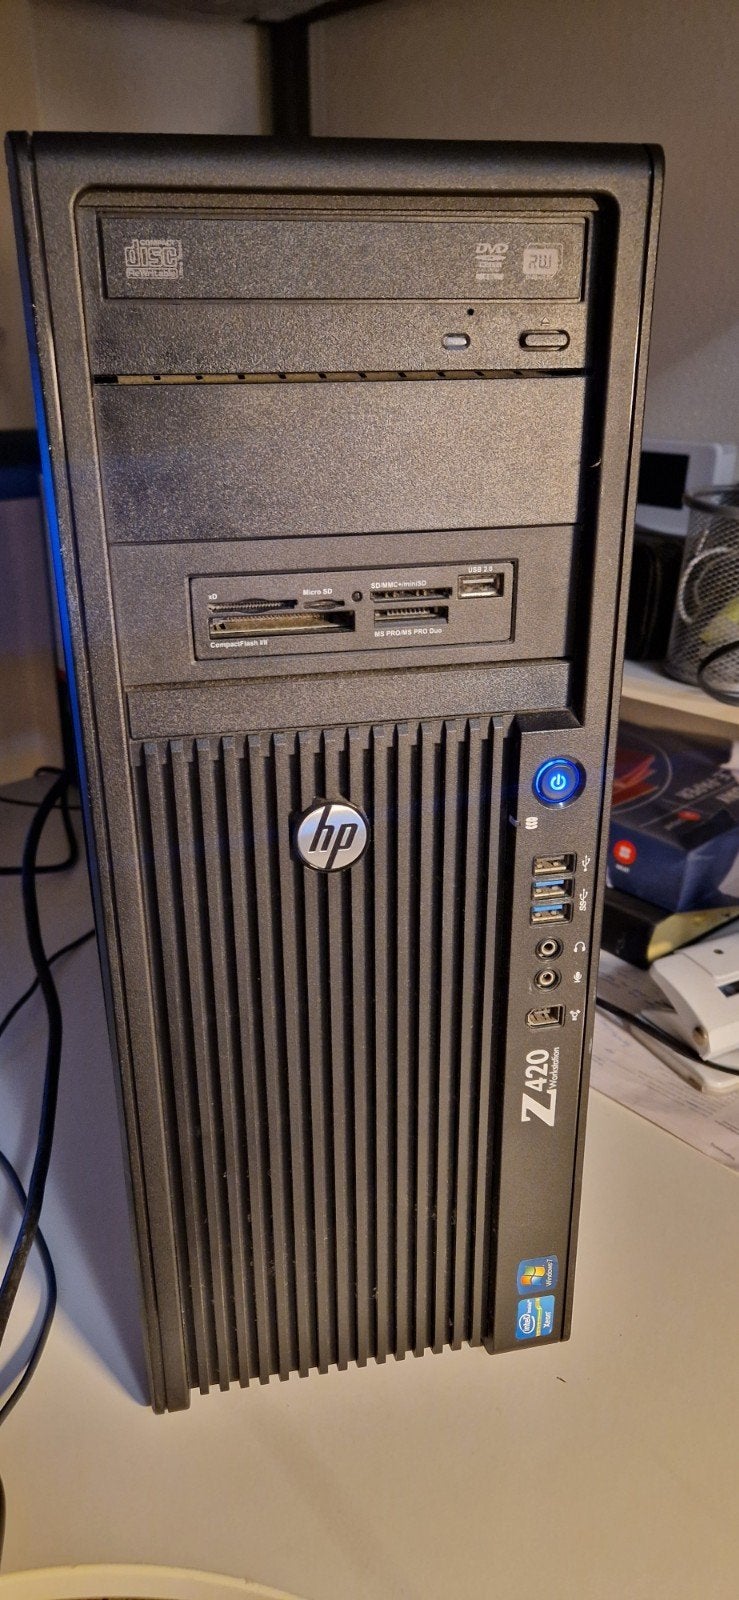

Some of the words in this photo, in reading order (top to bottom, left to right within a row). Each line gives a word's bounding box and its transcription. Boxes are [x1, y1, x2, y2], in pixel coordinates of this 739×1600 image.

[125, 239, 177, 267] disc
[475, 242, 509, 253] DVD
[371, 580, 427, 589] SD/MMC+/miniSD
[386, 629, 412, 637] PRO/MS
[429, 627, 443, 635] Duo
[210, 640, 258, 649] CompactFlash
[309, 805, 358, 869] hp
[549, 1046, 560, 1089] Workstation
[543, 1312, 551, 1328] Xeon
